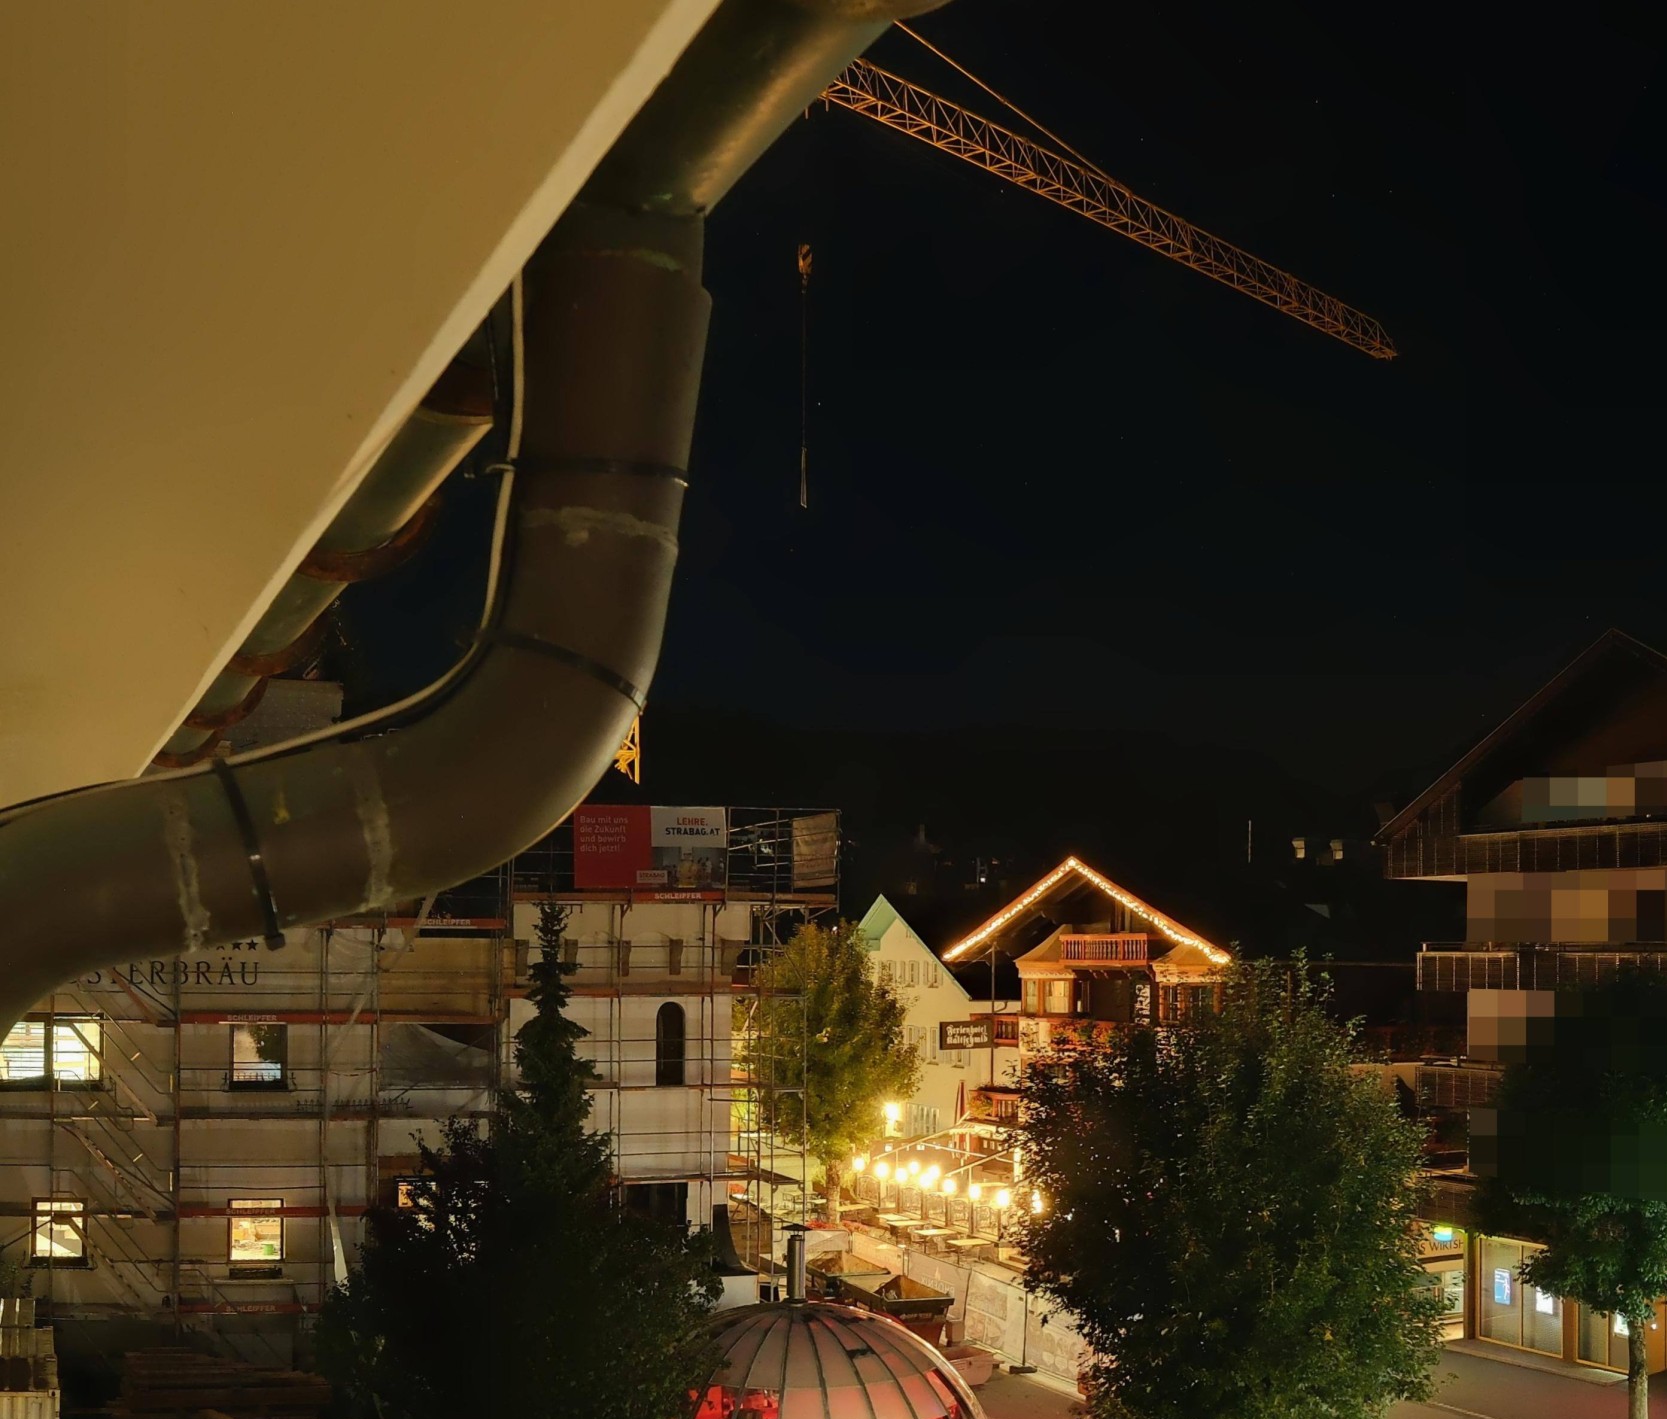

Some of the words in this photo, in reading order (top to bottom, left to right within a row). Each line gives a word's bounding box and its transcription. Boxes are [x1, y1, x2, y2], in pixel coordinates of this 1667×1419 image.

[676, 817, 709, 826] LEHRE.
[665, 827, 721, 836] STRABAG.AT
[225, 1207, 276, 1215] SCHLEIPFER
